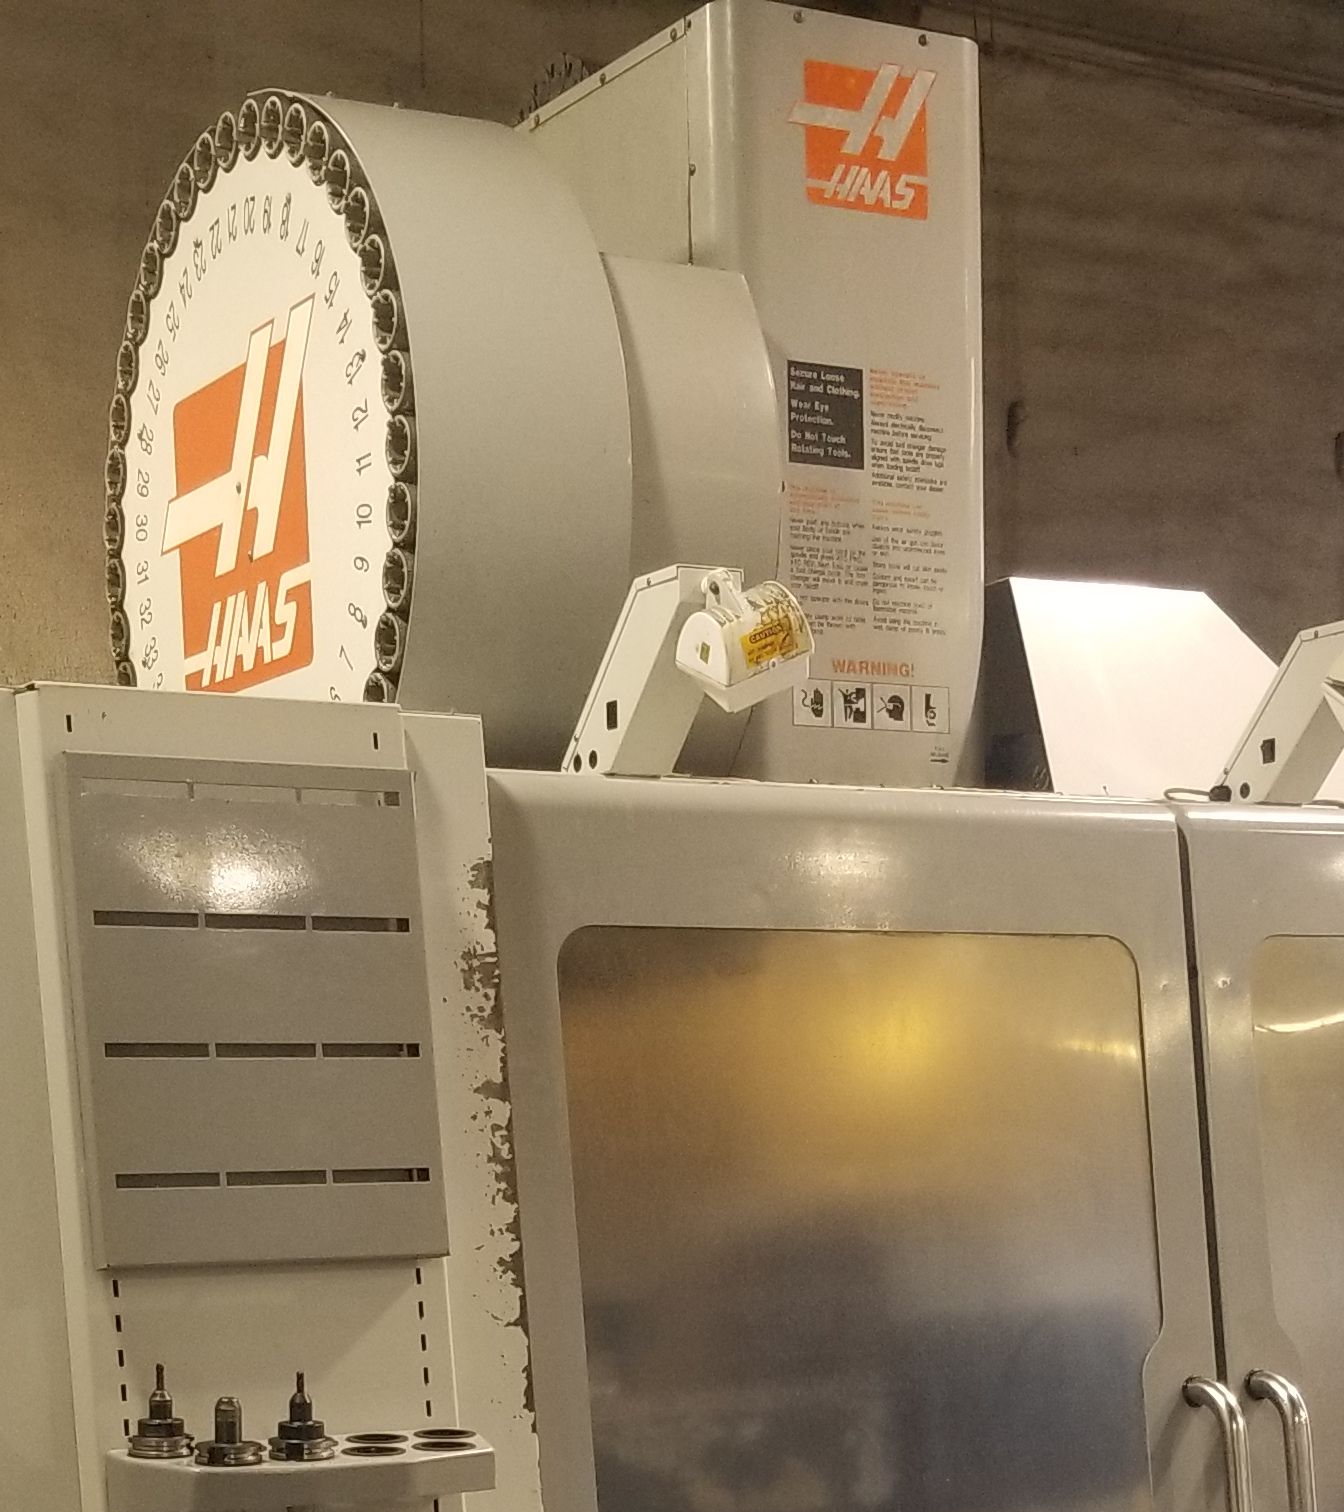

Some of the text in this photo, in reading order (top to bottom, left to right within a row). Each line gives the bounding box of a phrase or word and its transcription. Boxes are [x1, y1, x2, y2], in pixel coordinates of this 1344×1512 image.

[806, 164, 930, 209] HAAS
[228, 203, 237, 243] 21
[244, 196, 255, 235] 20
[209, 218, 222, 259] 22
[193, 240, 206, 281] 23
[311, 239, 325, 279] 16
[179, 267, 192, 308] 24
[325, 271, 340, 309] 15
[166, 299, 179, 342] 25
[336, 308, 352, 344] 14
[155, 338, 169, 376] 26
[346, 351, 365, 385] 13
[147, 379, 160, 415] 27
[352, 398, 369, 431] 12
[140, 423, 154, 455] 28
[356, 452, 372, 476] 11
[137, 468, 150, 498] 29
[135, 514, 148, 542] 30
[356, 503, 373, 529] 10
[136, 560, 149, 585] 31
[354, 556, 370, 572] 9
[139, 598, 153, 630] 32
[185, 562, 312, 688] HAAS
[348, 603, 365, 623] 8
[144, 636, 158, 670] 33
[339, 645, 353, 671] 7
[831, 658, 915, 678] WARNING!
